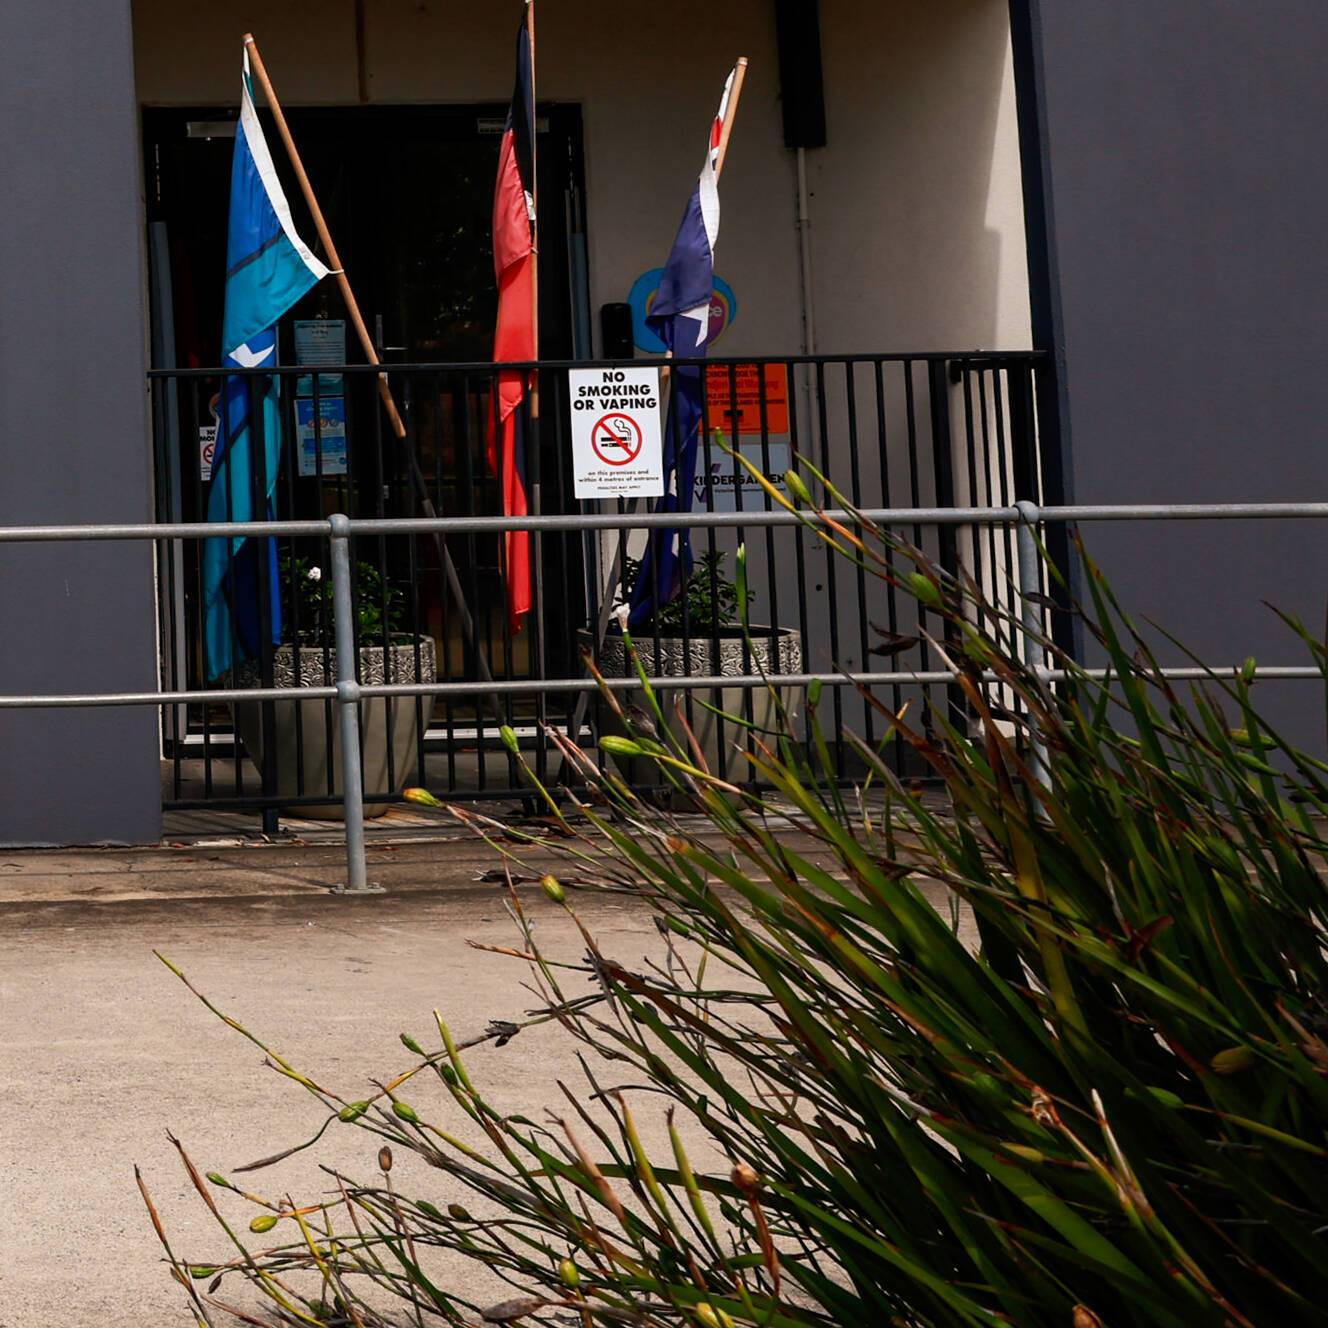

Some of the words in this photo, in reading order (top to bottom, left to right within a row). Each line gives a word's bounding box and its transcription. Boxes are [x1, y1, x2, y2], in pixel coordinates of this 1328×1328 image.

[602, 371, 625, 383] NO
[578, 384, 651, 397] SMOKING
[573, 399, 595, 410] OR
[599, 397, 657, 410] VAPING
